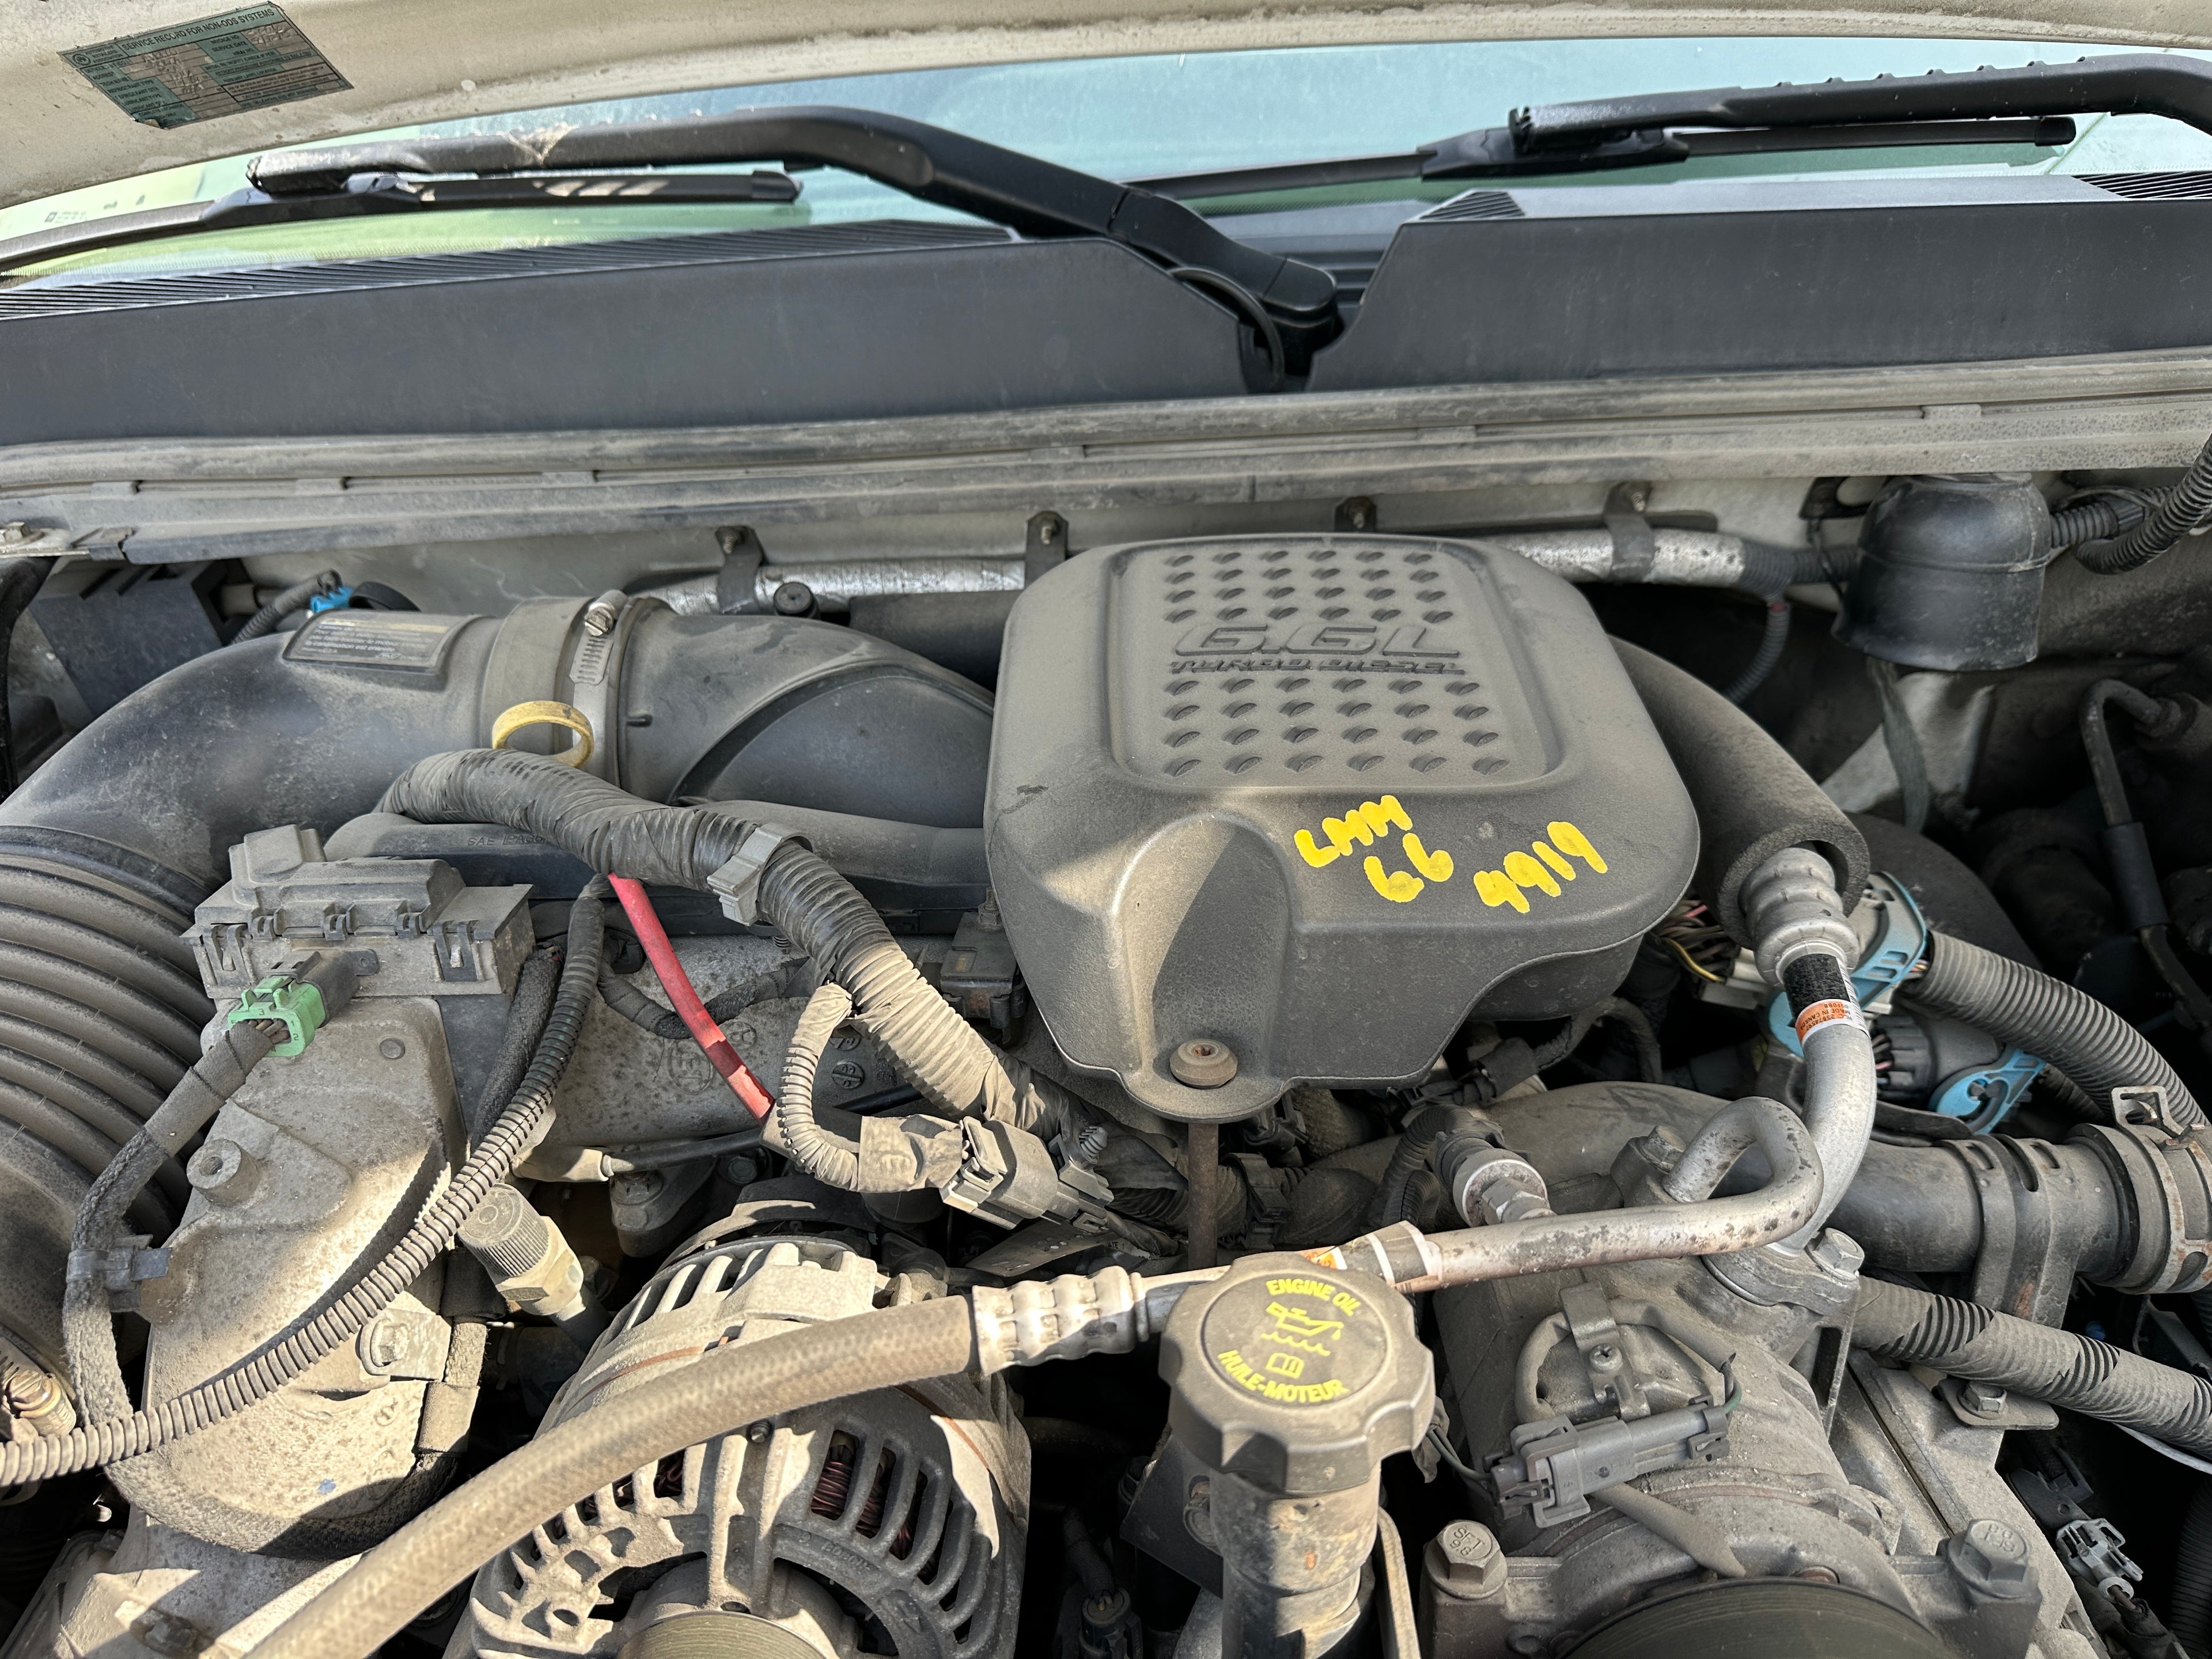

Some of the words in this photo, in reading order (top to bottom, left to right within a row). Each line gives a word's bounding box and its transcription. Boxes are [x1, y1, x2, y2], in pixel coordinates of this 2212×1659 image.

[122, 35, 154, 50] SERVICE
[154, 29, 185, 44] RECORD
[187, 25, 203, 36] FOR
[203, 16, 238, 32] NON-ODS
[238, 9, 275, 24] SYSTEMS
[1175, 623, 1460, 657] 6.6L
[1170, 658, 1311, 675] TURBO
[1319, 659, 1466, 675] DIESEL
[1294, 795, 1412, 868] LMM
[1266, 1278, 1336, 1301] ENGINE
[1332, 1292, 1362, 1317] OIL
[1217, 1350, 1350, 1403] HUILE-MOTEUR
